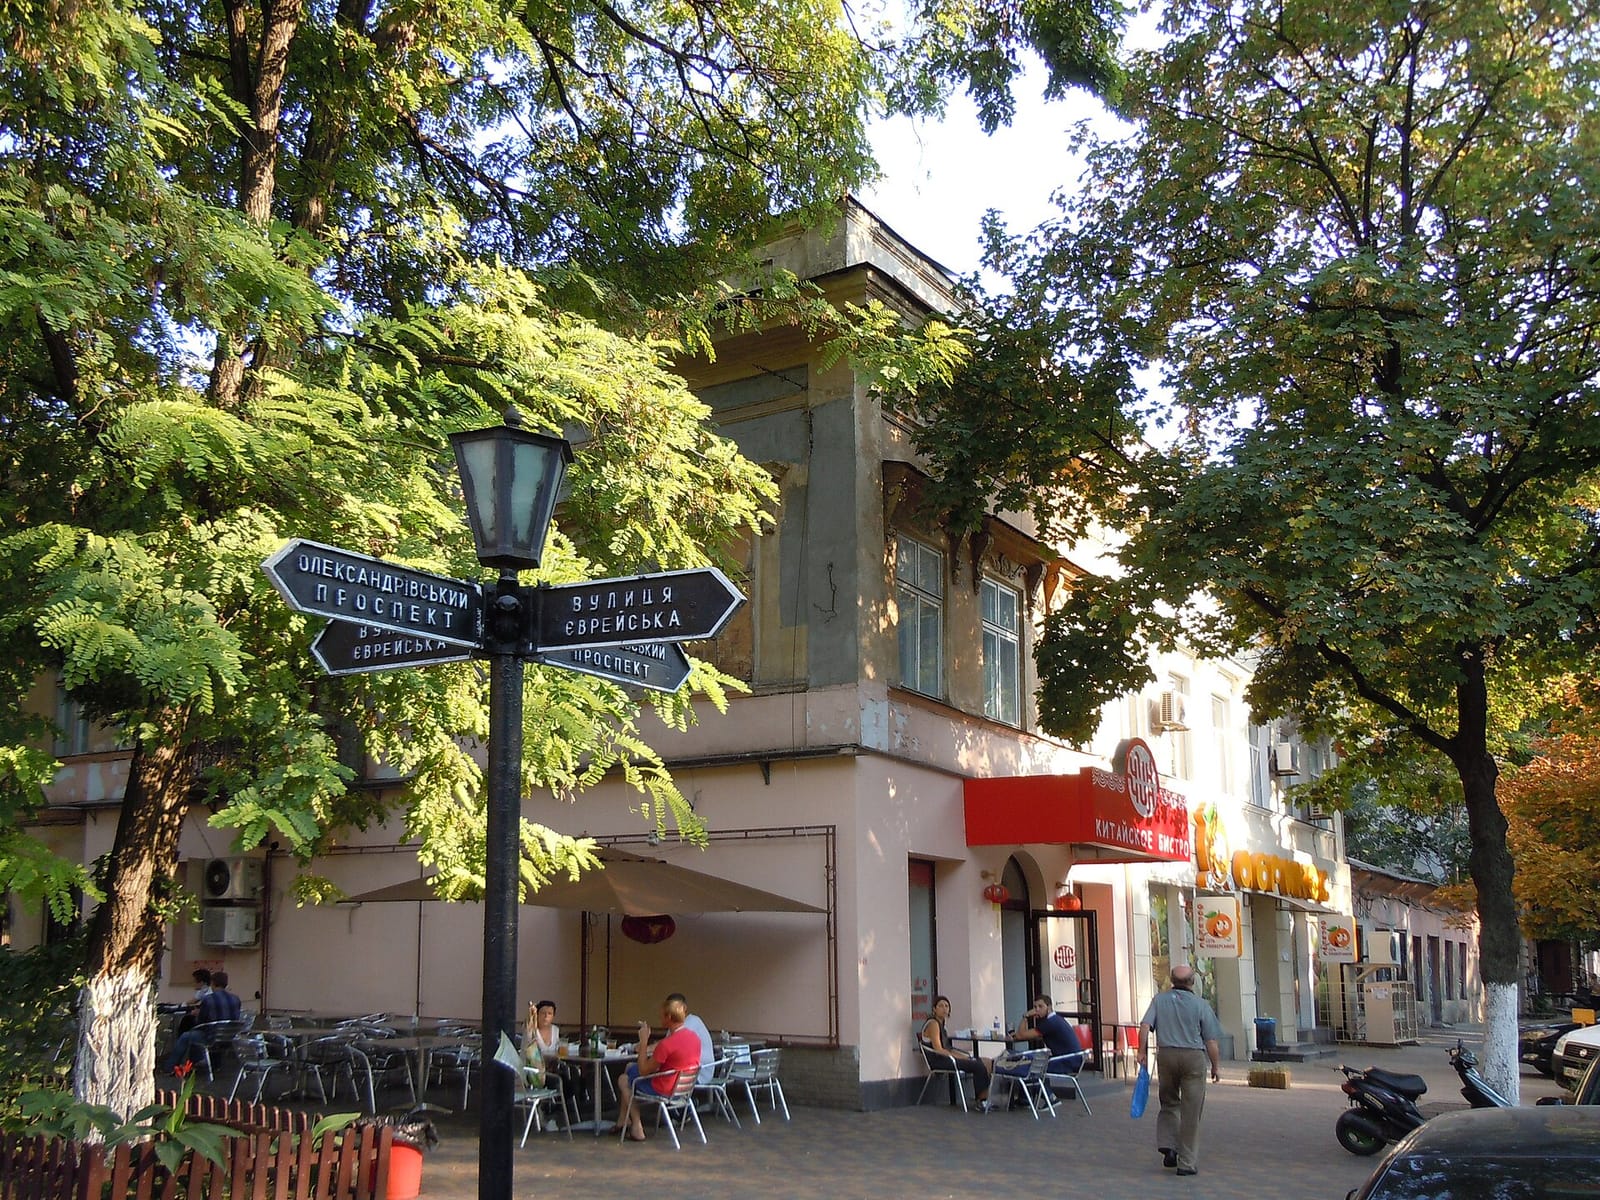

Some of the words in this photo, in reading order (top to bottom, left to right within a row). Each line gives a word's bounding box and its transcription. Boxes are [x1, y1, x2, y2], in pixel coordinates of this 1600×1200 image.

[299, 553, 469, 610] ОЛЕКСАНДРІВСЬКИЙ
[317, 583, 453, 628] ПРОСПЕКТ
[572, 586, 673, 613] ВУЛИЦЯ
[565, 609, 681, 637] ЄВРЕЙСЬКА
[574, 648, 651, 679] ПРОСПЕКТ
[1095, 818, 1153, 850] КИТАЙСКОЕ
[1158, 832, 1189, 858] БИСТРО
